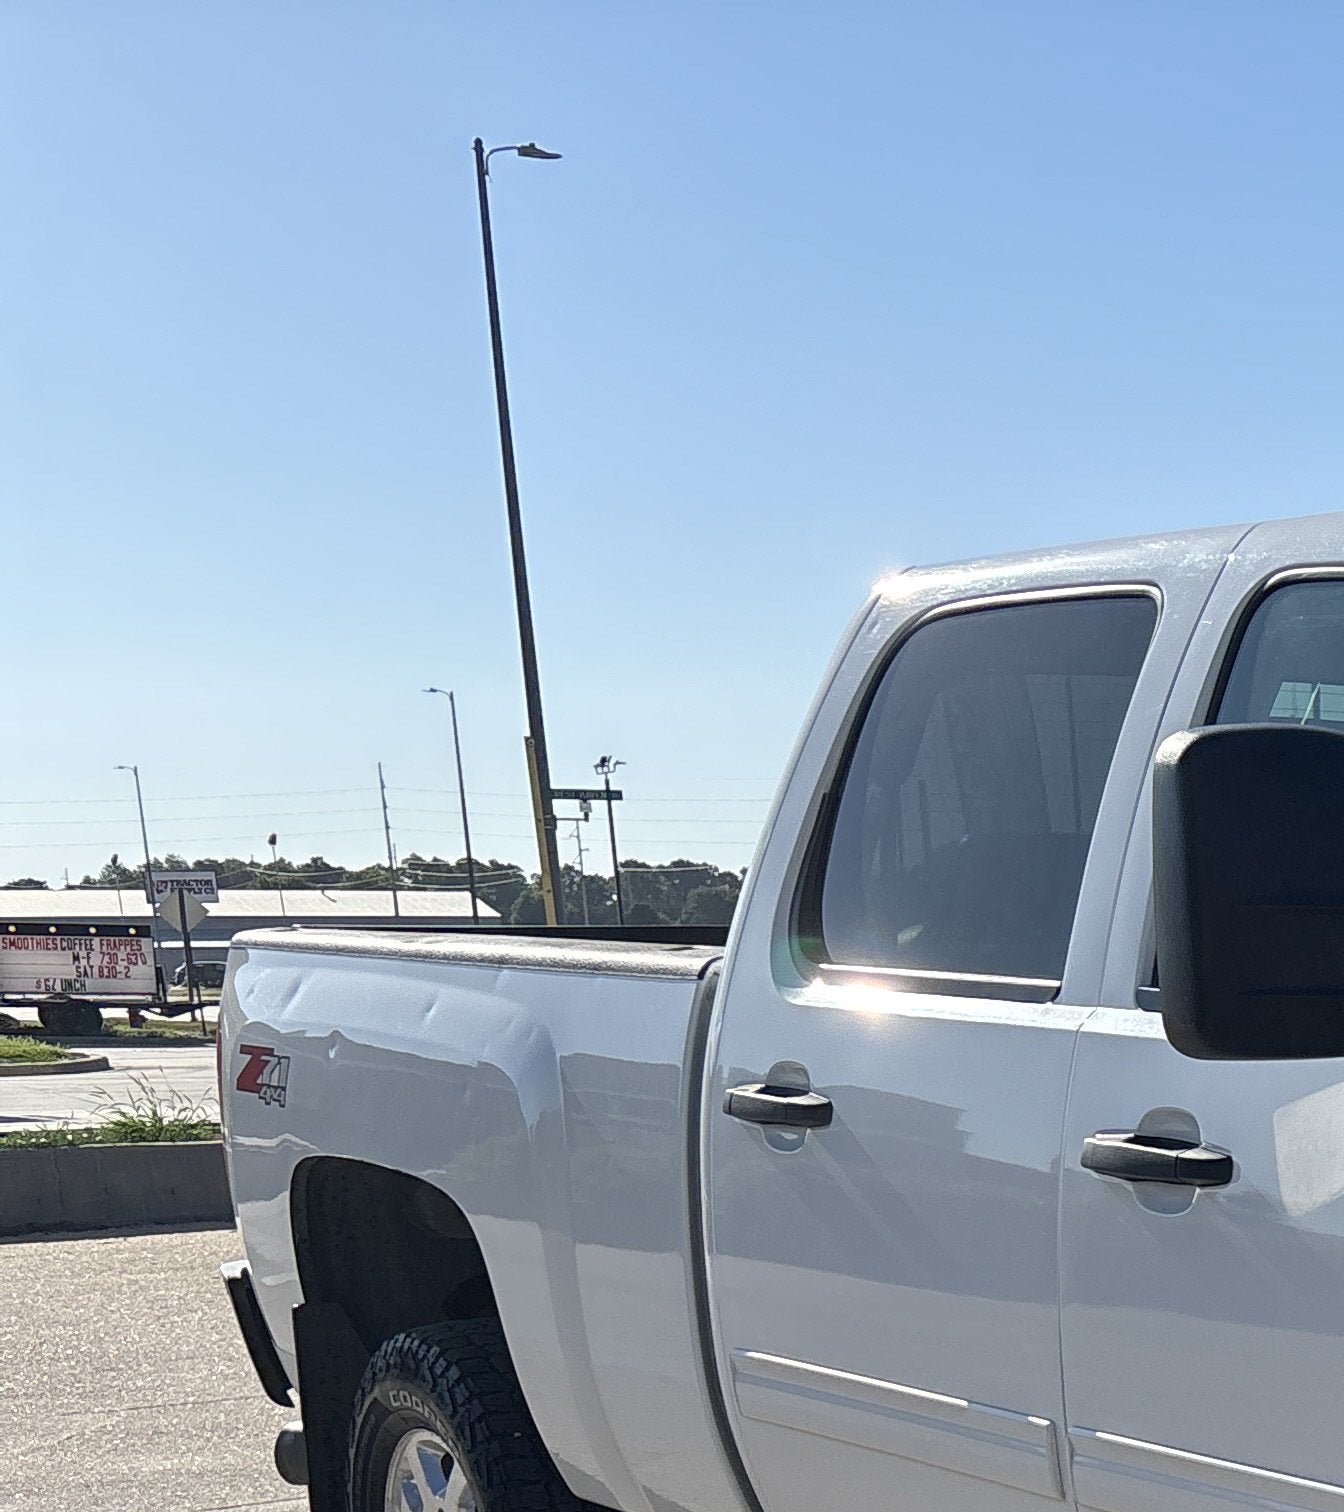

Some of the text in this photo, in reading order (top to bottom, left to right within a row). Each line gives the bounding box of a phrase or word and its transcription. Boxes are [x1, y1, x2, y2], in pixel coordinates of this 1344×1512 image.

[169, 879, 213, 887] TRACTOR
[2, 937, 142, 951] SMOOTHIES COFFEE FRAPPES
[72, 951, 148, 966] M-F 730-630
[75, 965, 131, 979] SAT 830-2
[236, 1044, 290, 1093] Z71
